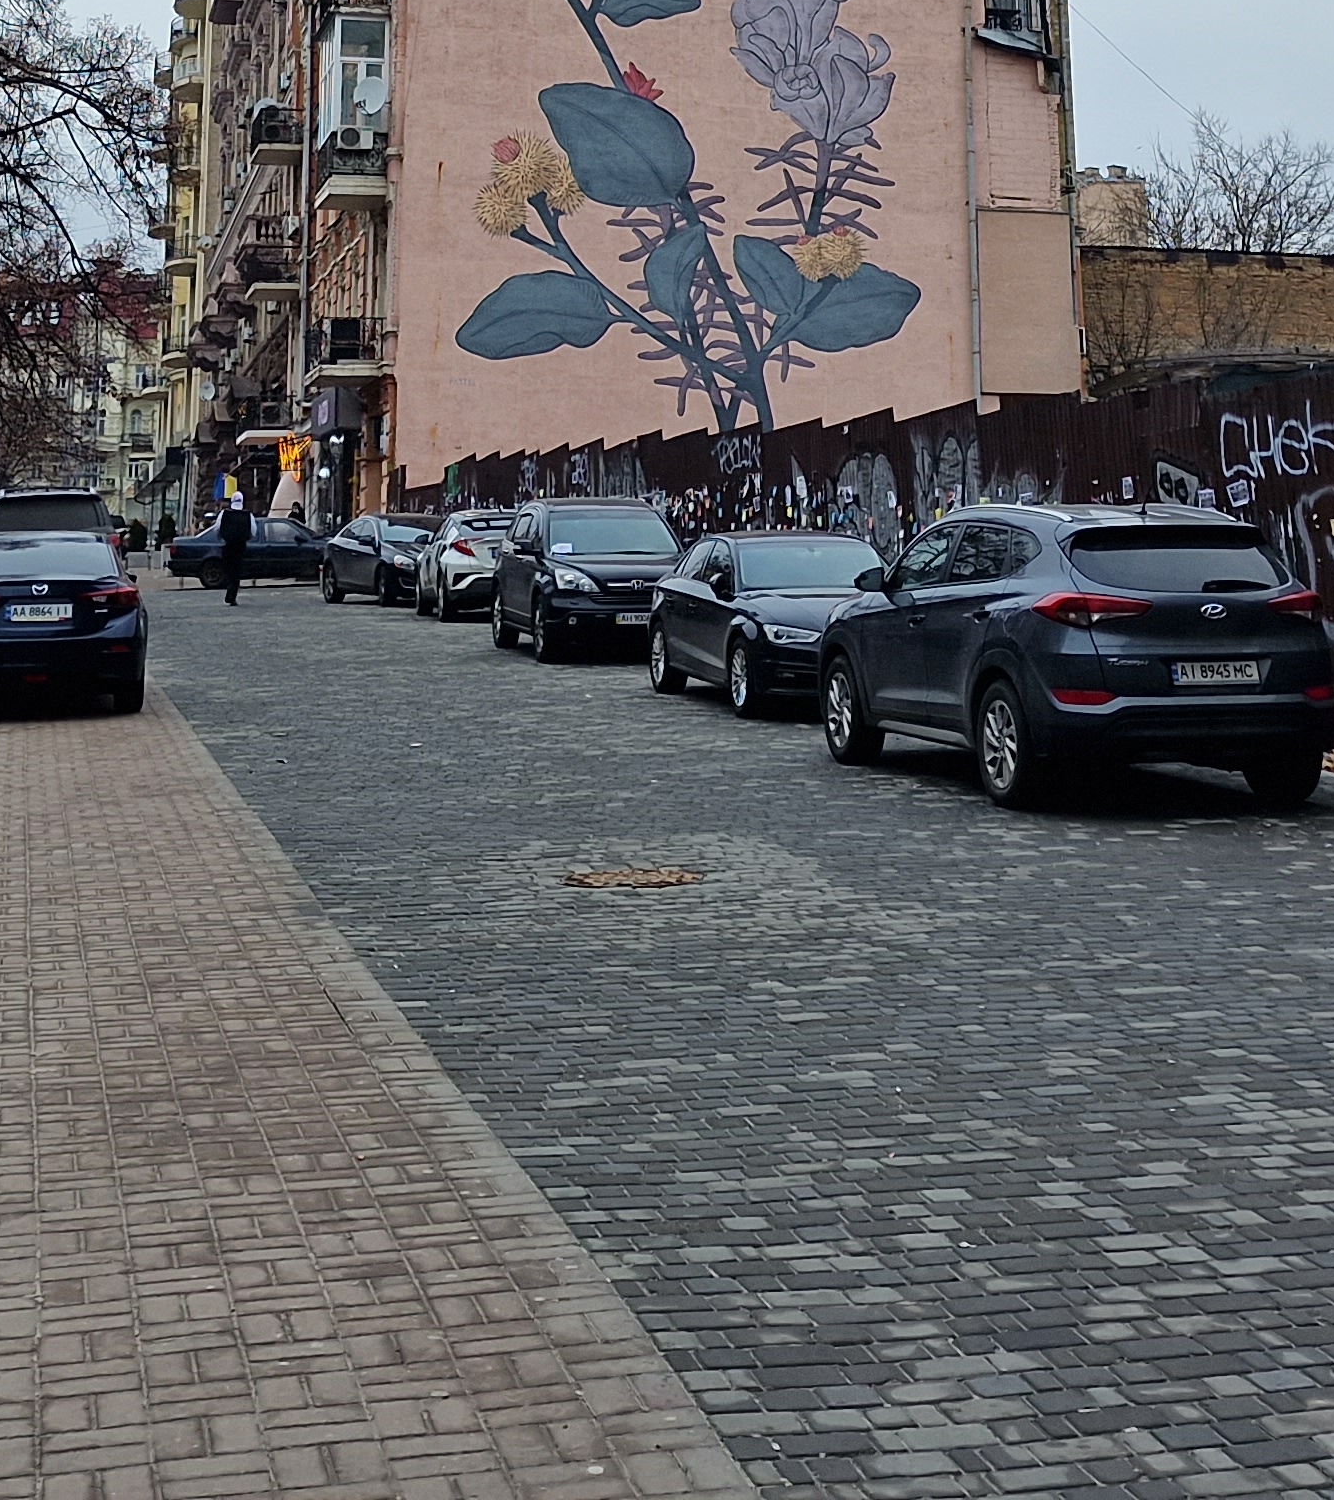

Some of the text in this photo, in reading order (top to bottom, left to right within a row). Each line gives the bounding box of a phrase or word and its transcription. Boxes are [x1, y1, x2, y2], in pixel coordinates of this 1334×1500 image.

[12, 607, 26, 617] AA
[1180, 664, 1254, 679] AI 8945 MC
